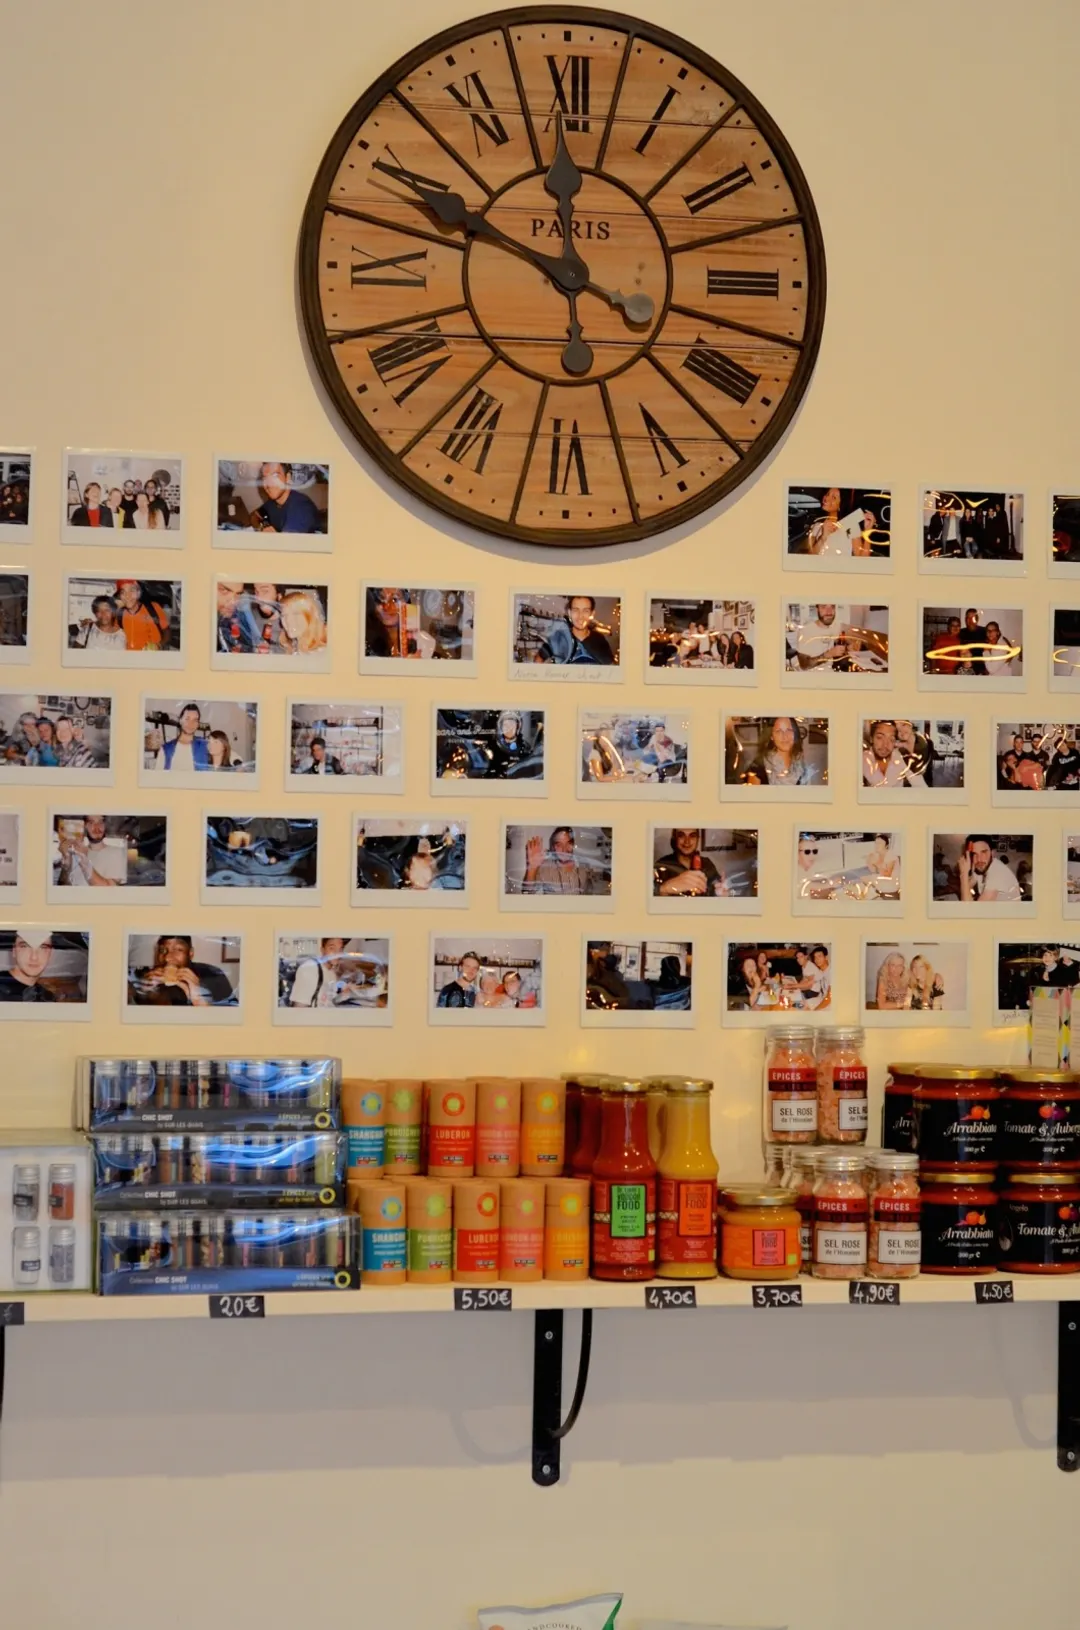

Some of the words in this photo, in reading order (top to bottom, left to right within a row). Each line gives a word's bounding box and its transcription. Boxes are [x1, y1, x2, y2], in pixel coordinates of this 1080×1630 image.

[543, 55, 593, 133] XII
[531, 218, 610, 240] PARIS
[351, 245, 427, 291] IX
[706, 266, 779, 301] III
[780, 1108, 794, 1116] SEL
[848, 1106, 859, 1114] SEL
[1004, 1120, 1037, 1134] Tomate
[617, 1201, 640, 1210] FOOD
[880, 1200, 910, 1211] ÉPICES
[1017, 1223, 1056, 1236] Tomate
[825, 1239, 839, 1248] SEL
[842, 1240, 860, 1248] ROSE
[888, 1239, 901, 1248] SEL
[461, 1289, 511, 1310] 5,50€
[650, 1289, 694, 1309] 4,70€
[756, 1288, 802, 1308] 3,70€
[854, 1282, 895, 1304] 4,90€
[219, 1296, 260, 1317] 20€
